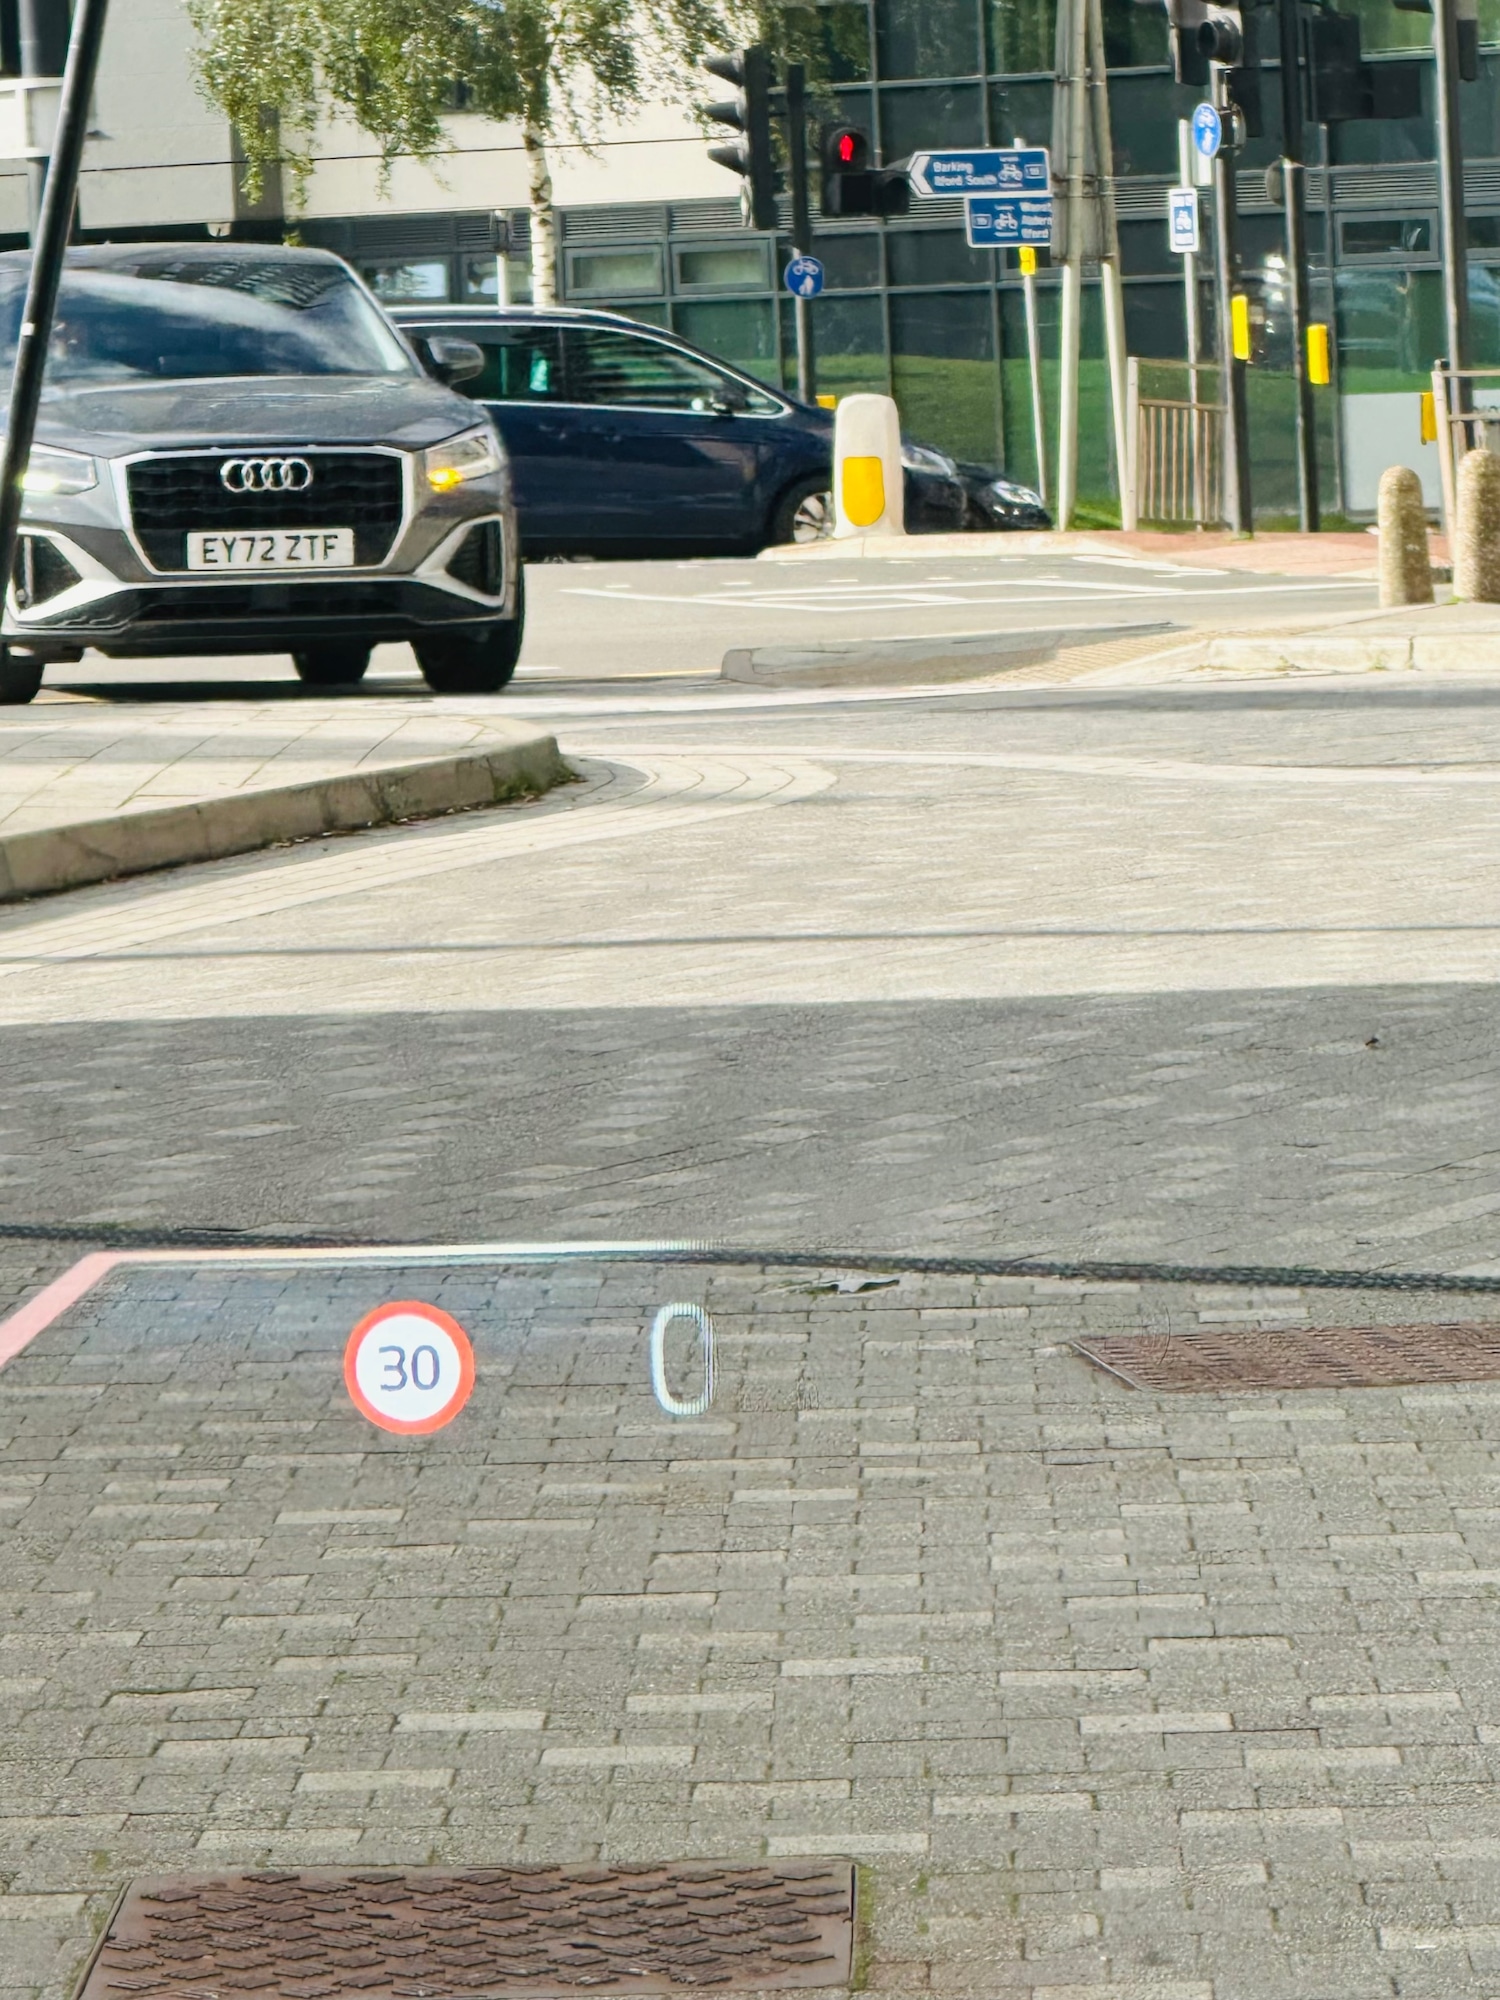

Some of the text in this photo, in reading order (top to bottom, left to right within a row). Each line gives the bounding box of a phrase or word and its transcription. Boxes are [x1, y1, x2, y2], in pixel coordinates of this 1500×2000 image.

[933, 162, 974, 174] Barking
[203, 534, 338, 563] EY72 ZTF
[378, 1345, 441, 1392] 30
[651, 1302, 717, 1415] 0
